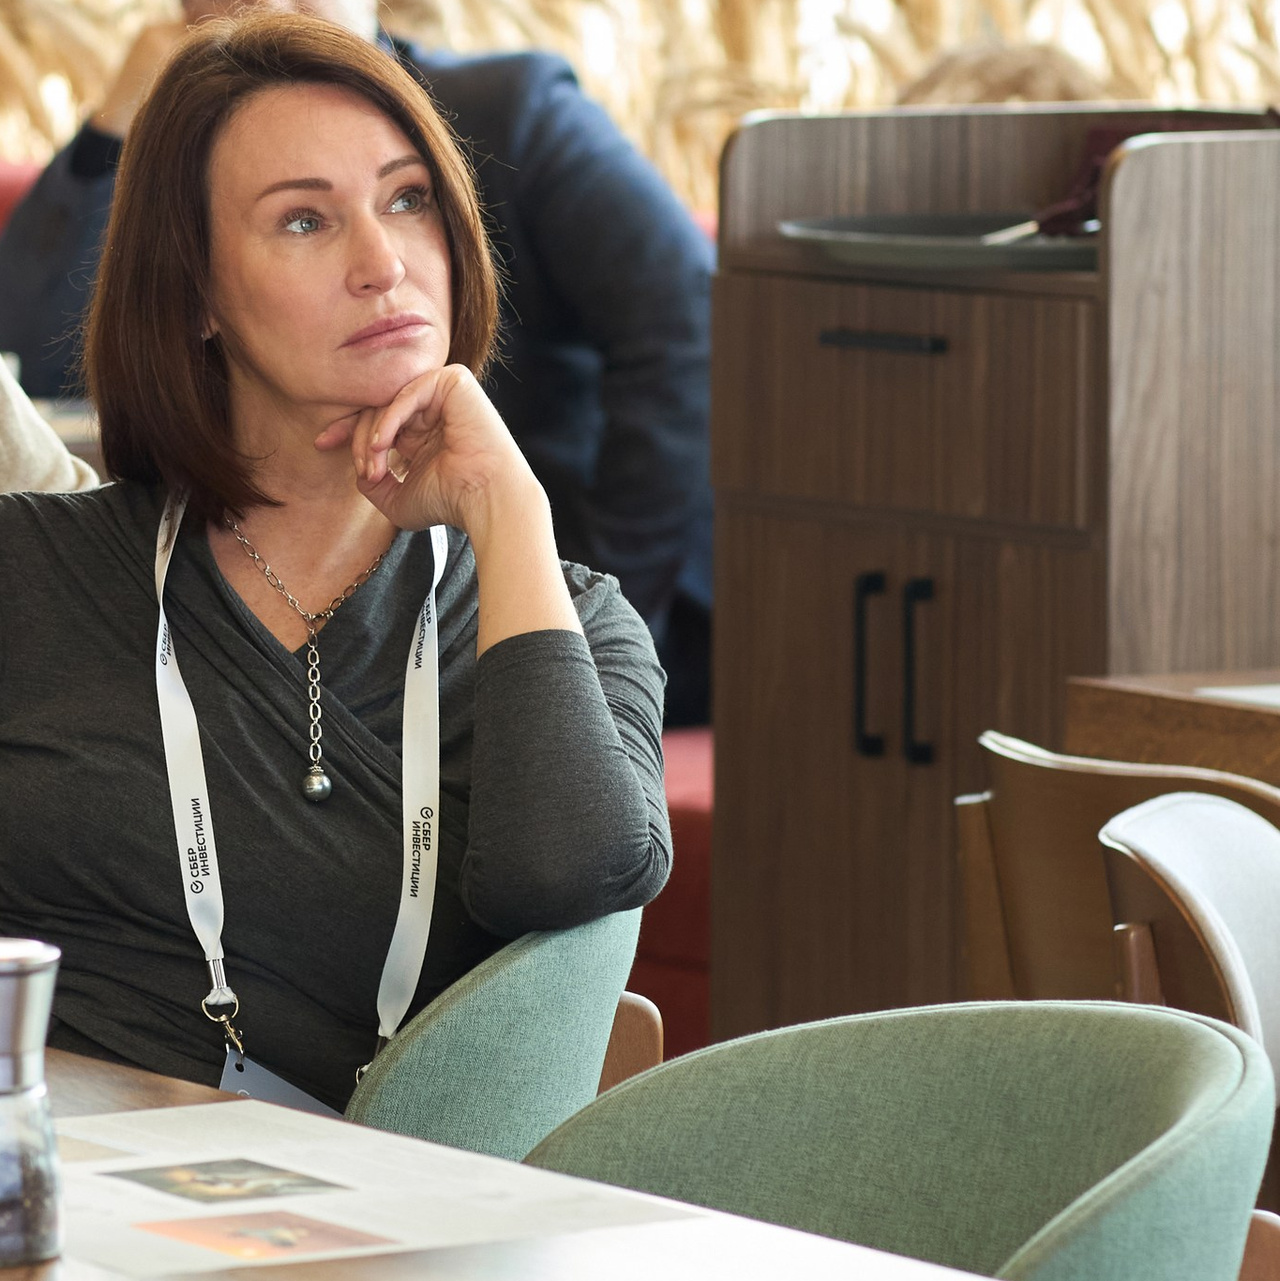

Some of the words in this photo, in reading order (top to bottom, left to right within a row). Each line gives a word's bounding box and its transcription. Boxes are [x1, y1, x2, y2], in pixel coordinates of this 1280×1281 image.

[187, 847, 200, 878] СБЕР
[191, 798, 211, 877] ИНВЕСТИЦИИ
[410, 820, 421, 898] ИНВЕСТИЦИИ
[422, 821, 432, 851] СБЕР
